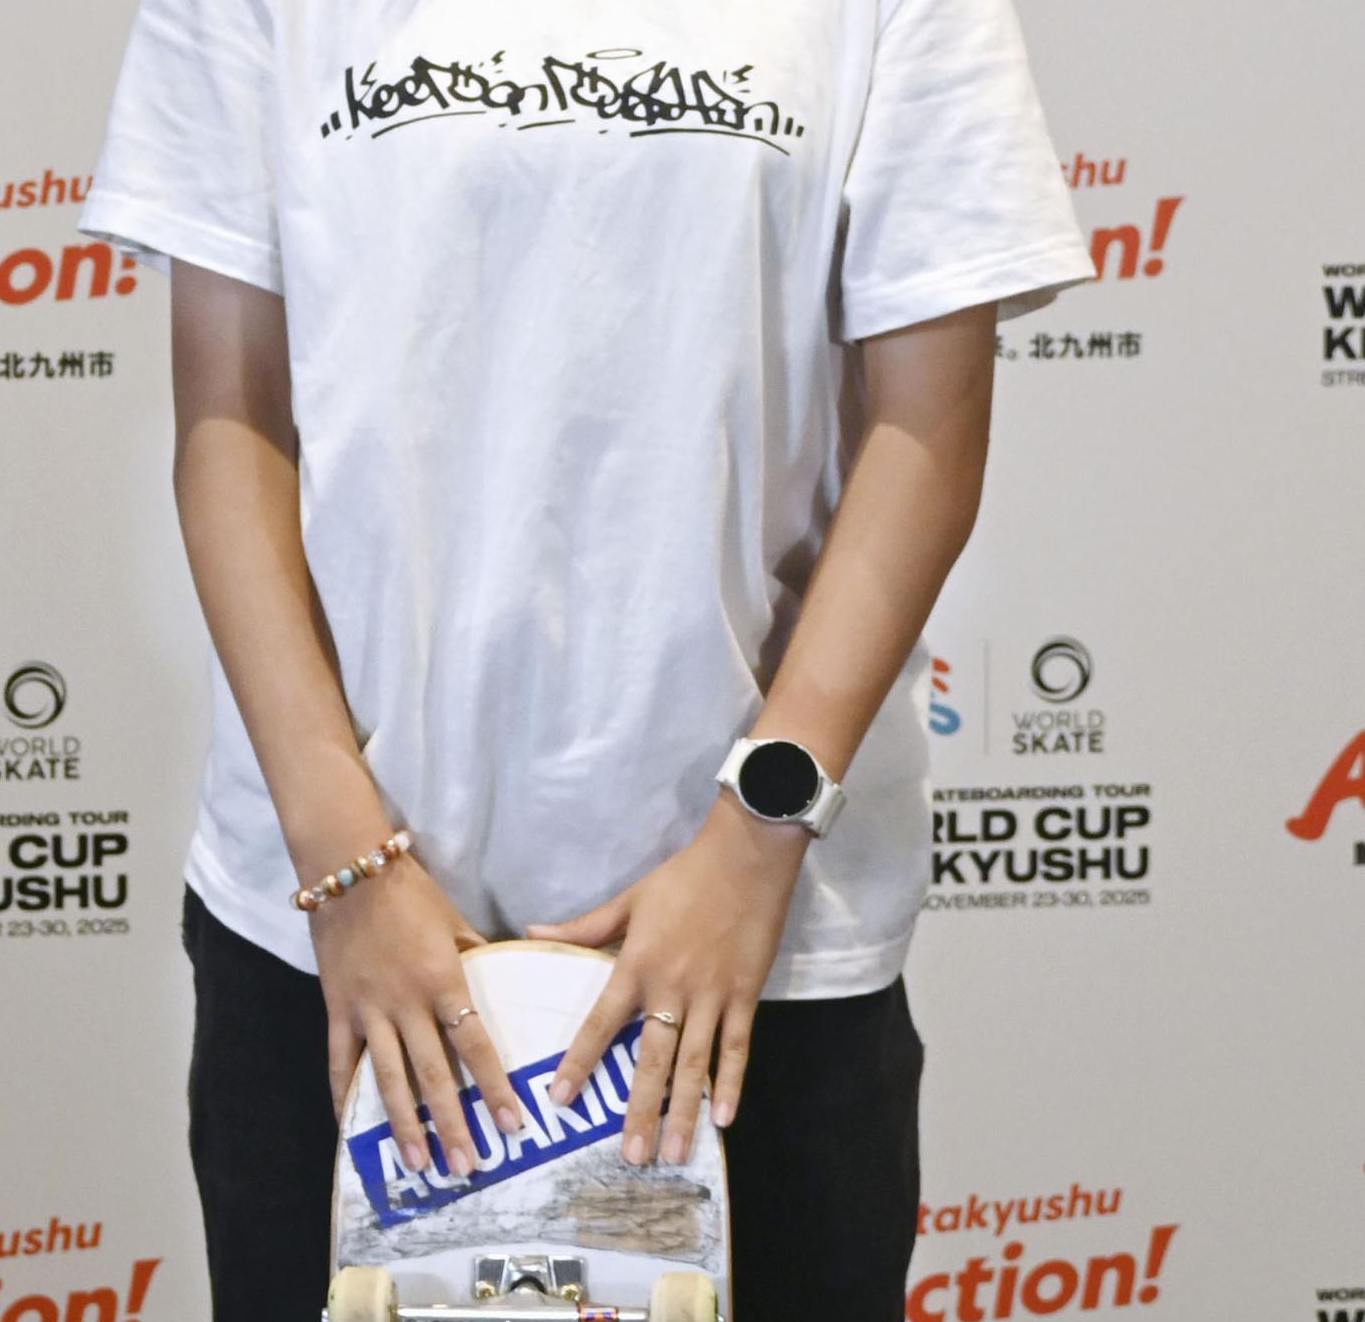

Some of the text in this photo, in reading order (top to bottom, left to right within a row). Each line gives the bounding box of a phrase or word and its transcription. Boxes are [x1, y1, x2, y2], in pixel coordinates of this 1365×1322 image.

[1029, 333, 1142, 359] 北九州市
[1012, 710, 1104, 730] WORLD
[1012, 731, 1104, 755] SKATE
[932, 783, 1151, 802] ATEBOARDING TOUR
[69, 811, 129, 826] TOUR
[1035, 805, 1150, 841] CUP
[9, 833, 129, 869] CUP
[932, 846, 1149, 884] KYUSHU
[77, 918, 130, 935] 2025
[915, 1183, 1123, 1235] takyushu
